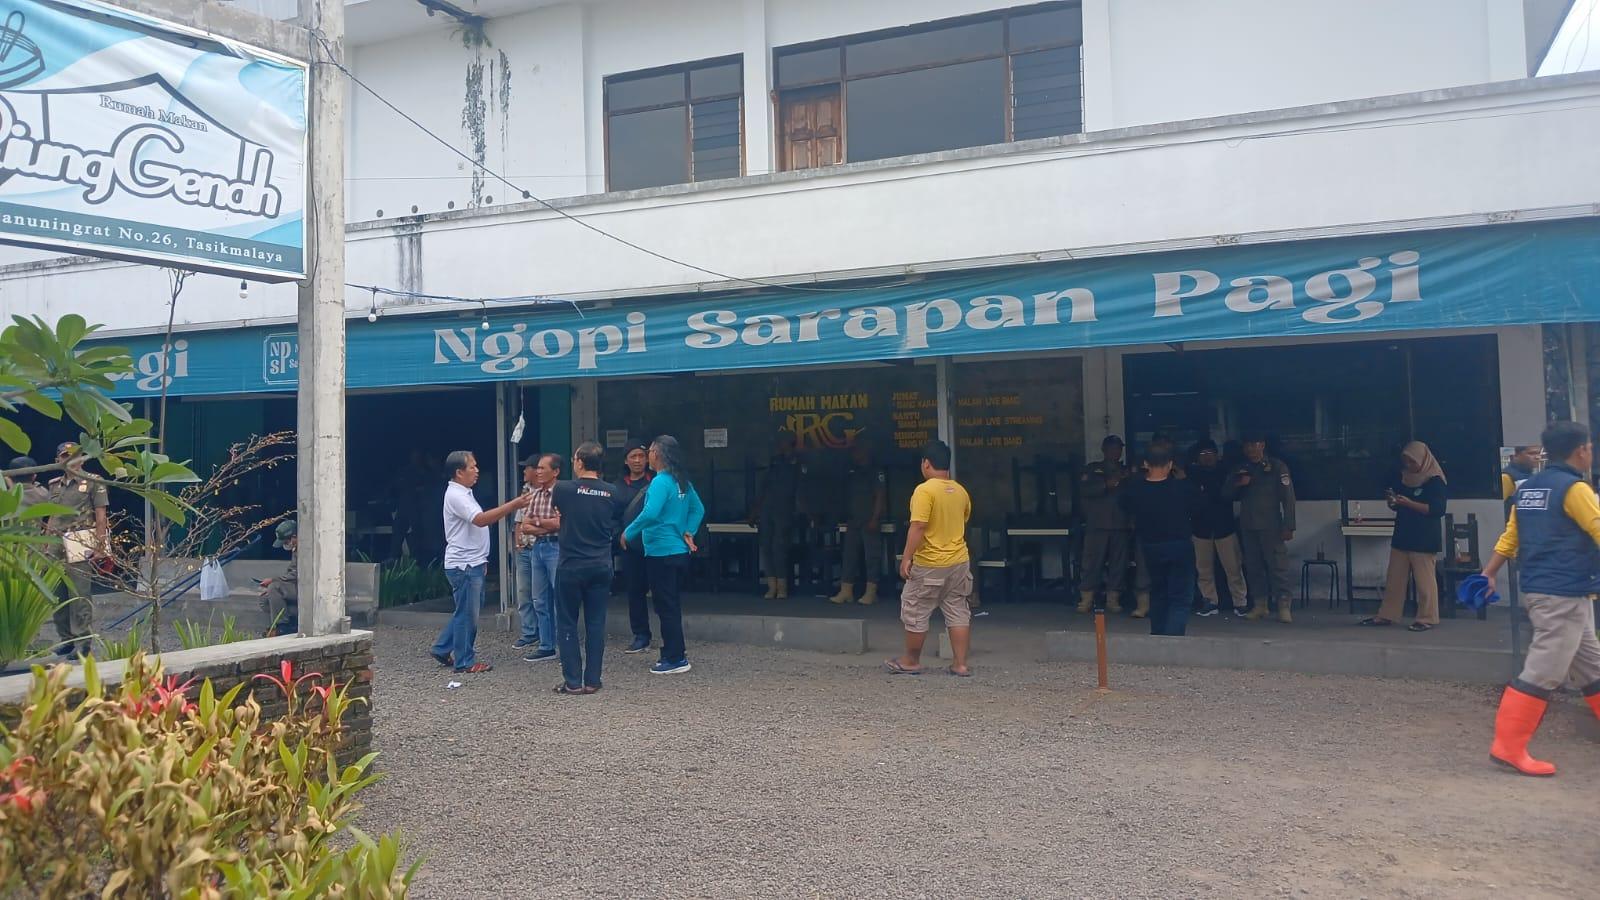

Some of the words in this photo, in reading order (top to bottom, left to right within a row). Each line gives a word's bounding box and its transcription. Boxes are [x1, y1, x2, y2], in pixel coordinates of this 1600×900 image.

[99, 94, 154, 119] Rumah
[157, 109, 208, 132] Makan
[118, 226, 179, 248] No.26,
[185, 237, 283, 263] Tasikmalaya
[433, 311, 648, 374] Ngopi
[684, 287, 1099, 349] Sarapan
[1151, 250, 1424, 324] Pagi
[769, 396, 816, 411] RUMAH
[820, 393, 869, 409] MAKAN
